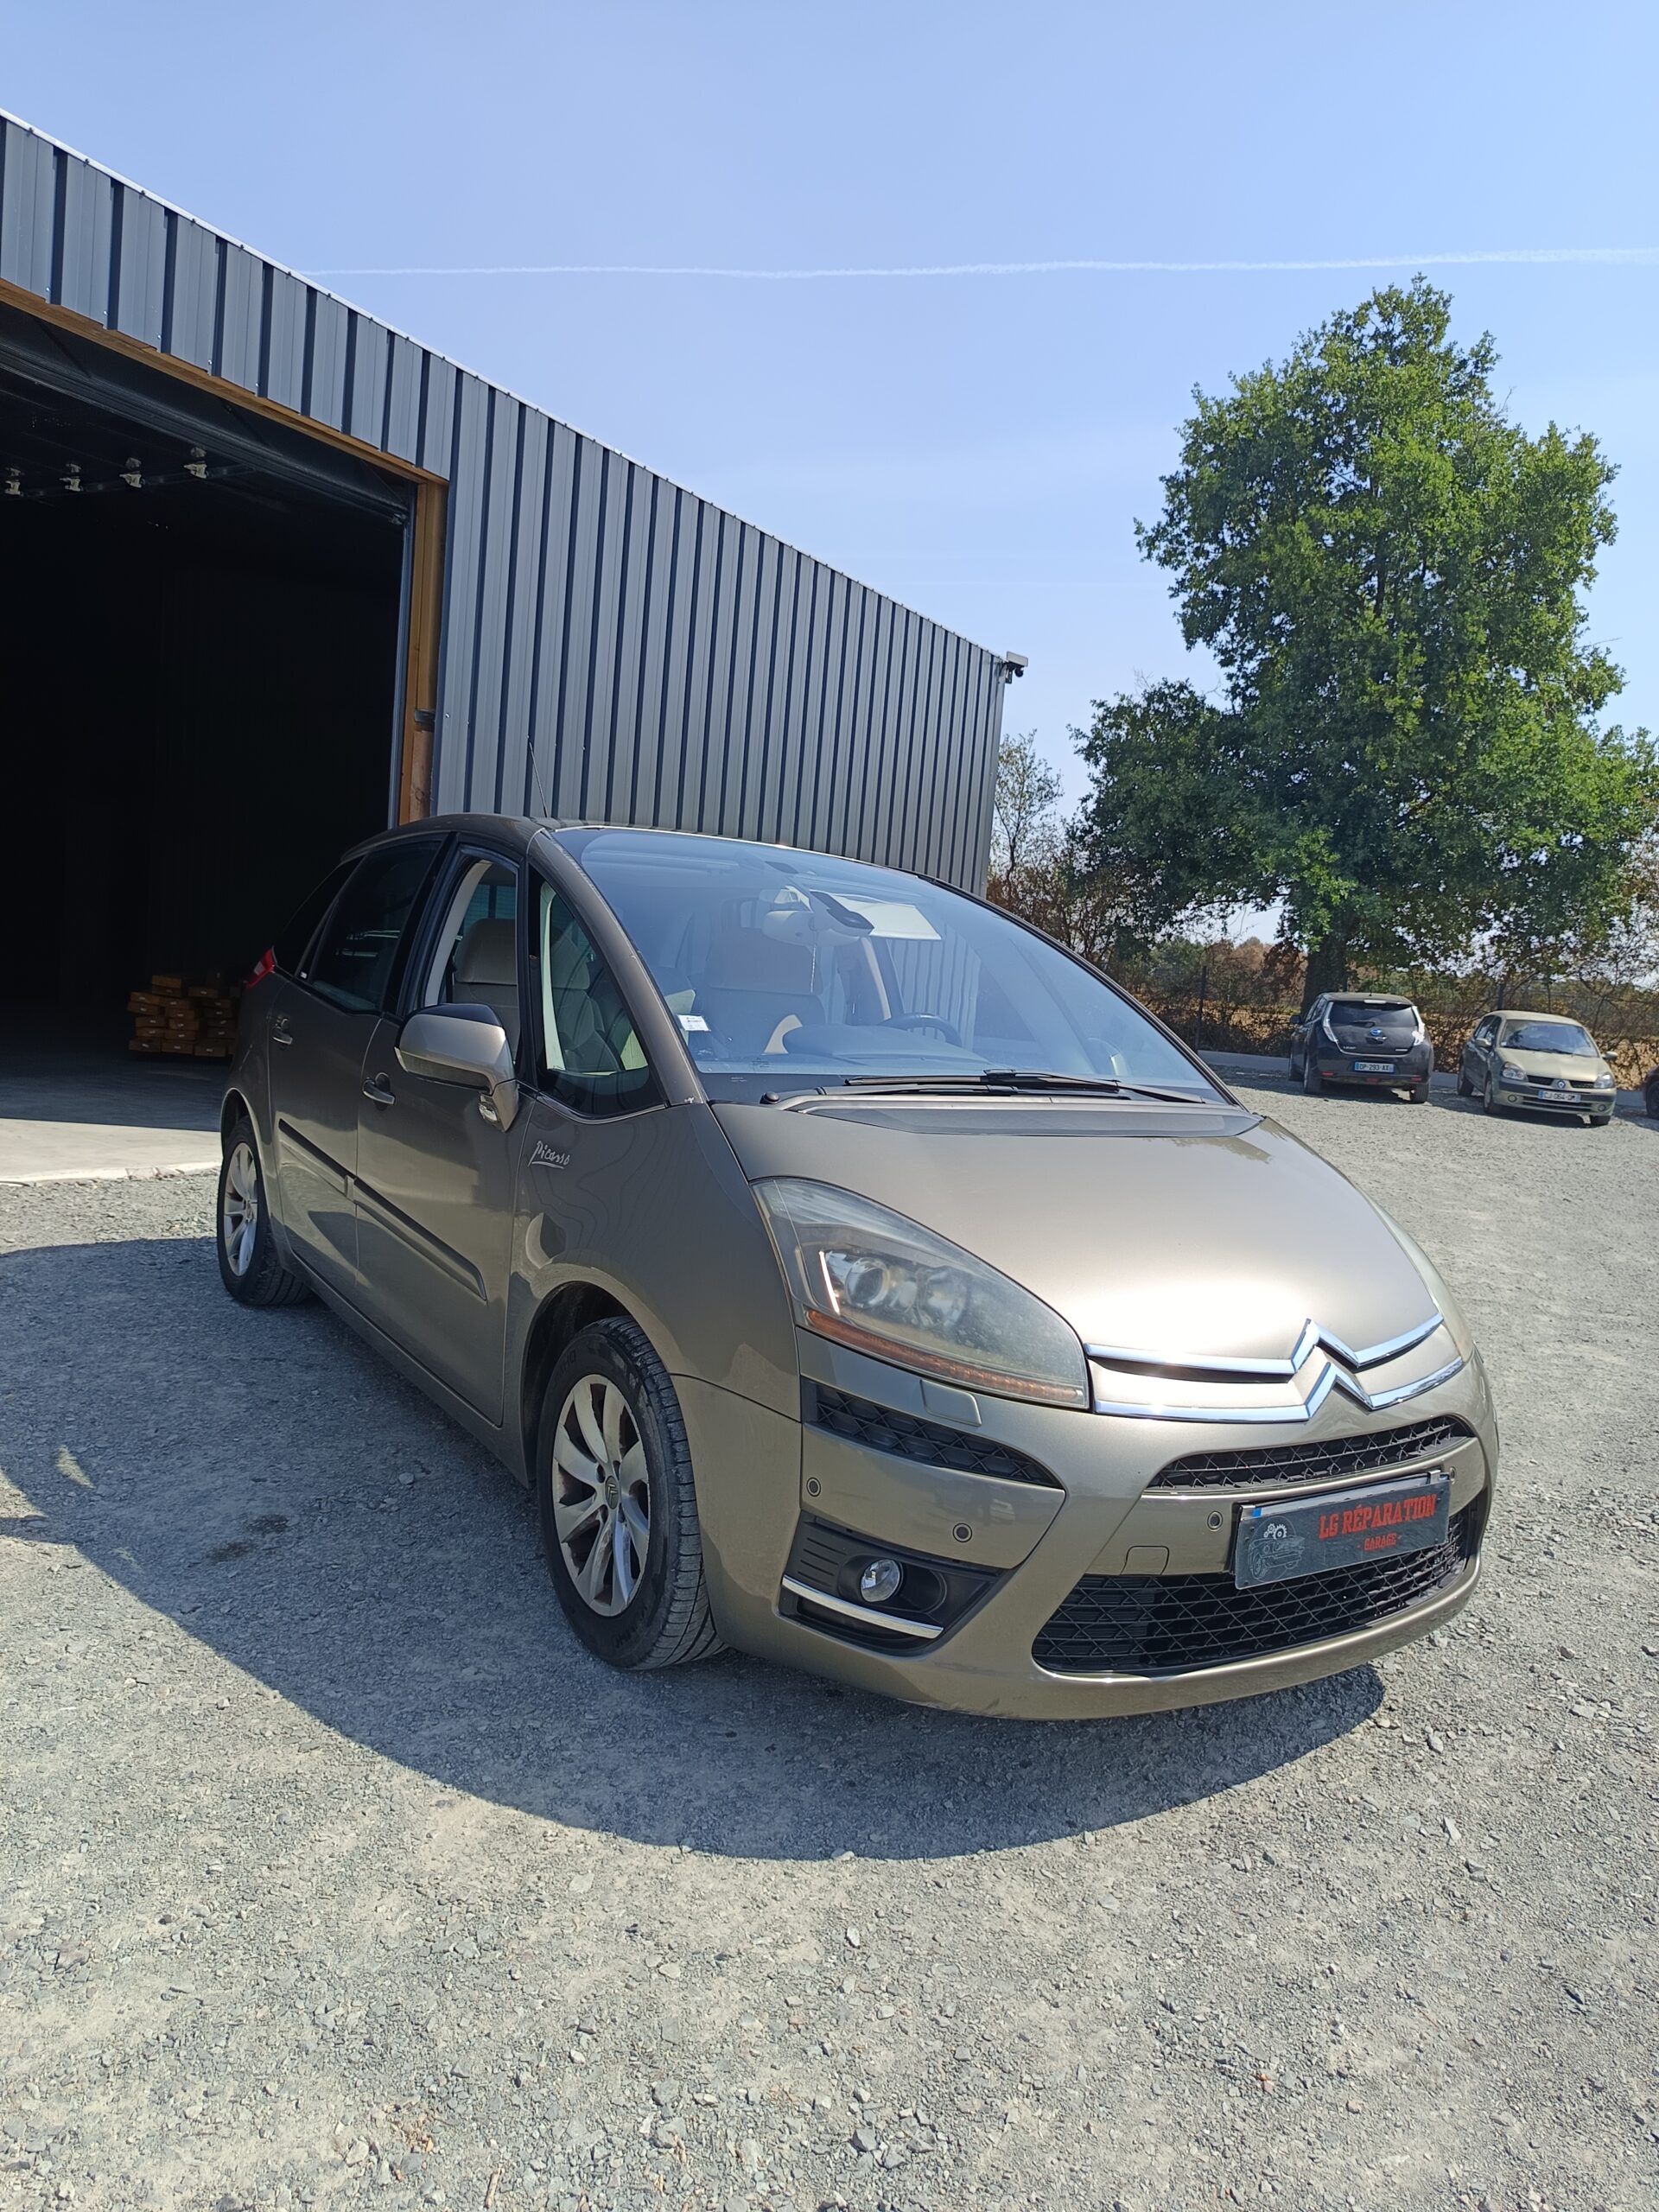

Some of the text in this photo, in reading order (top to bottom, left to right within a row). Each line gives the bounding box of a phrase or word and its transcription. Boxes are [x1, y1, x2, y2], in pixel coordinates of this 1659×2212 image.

[527, 1140, 570, 1167] Picasso
[1318, 1494, 1437, 1540] LG RÉPARATION
[1363, 1533, 1397, 1552] GARAGE
